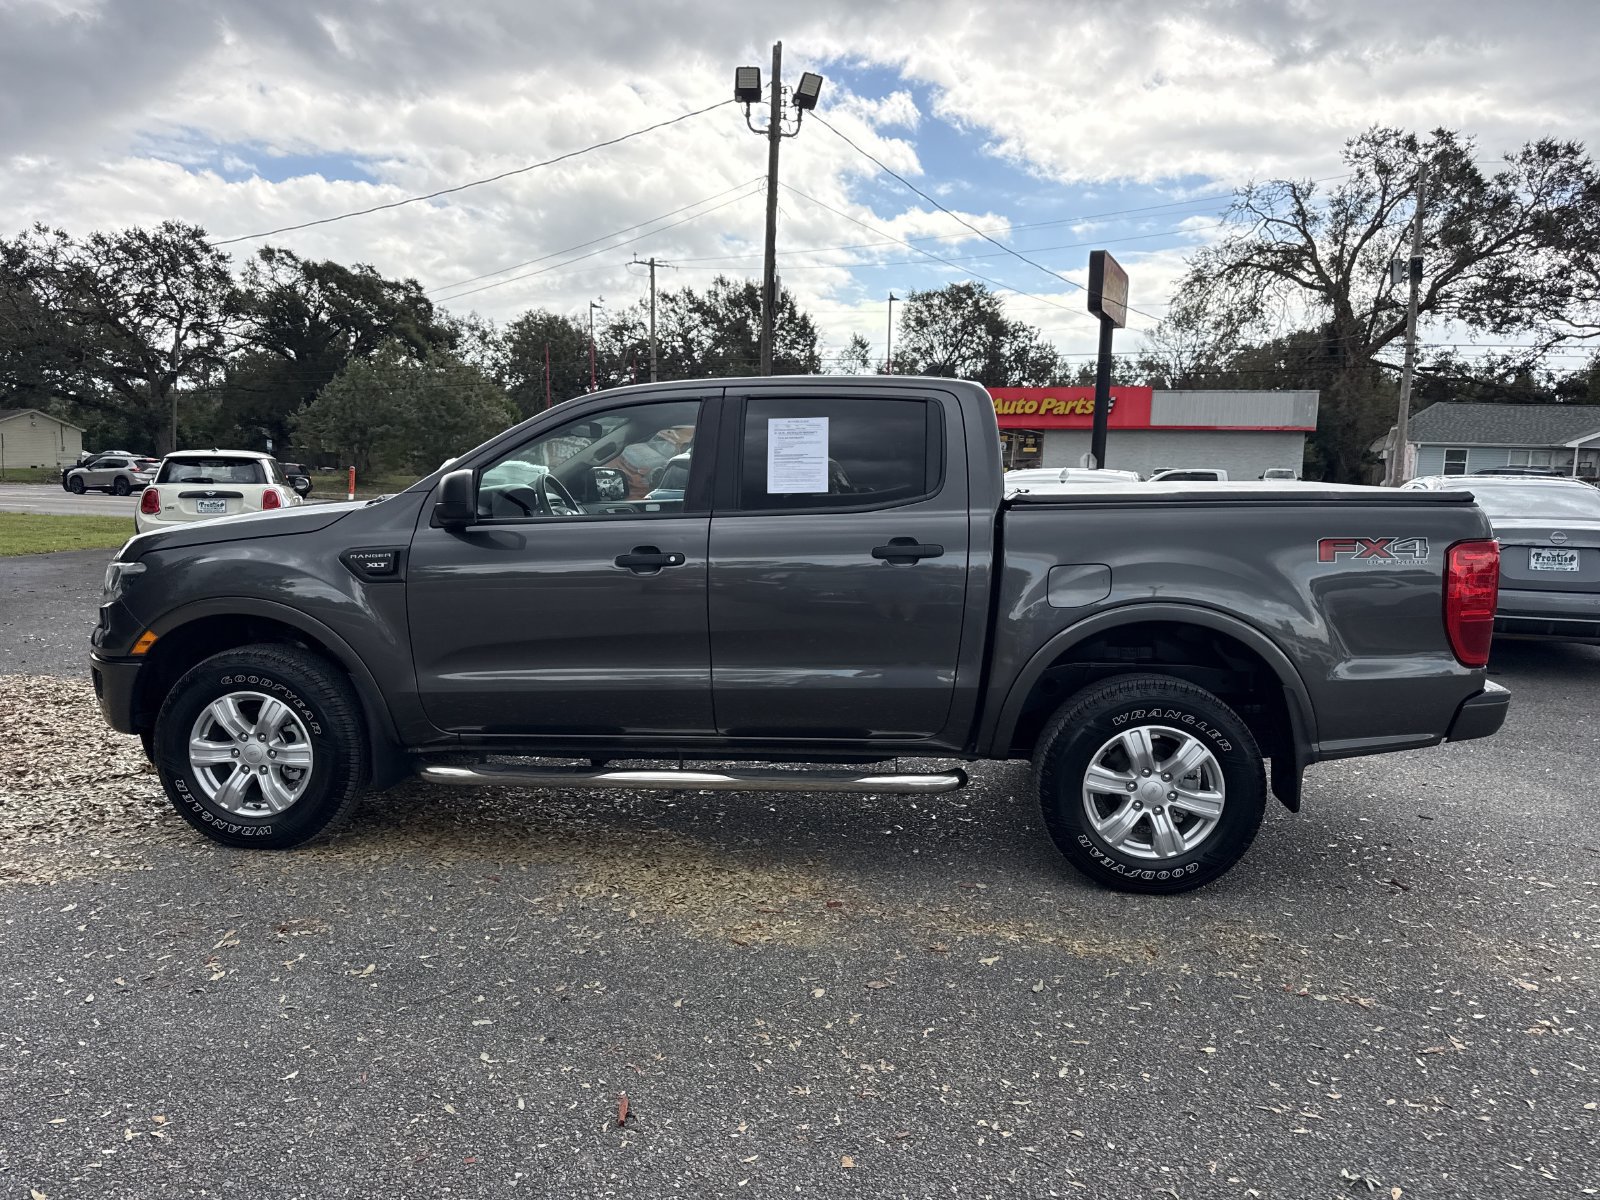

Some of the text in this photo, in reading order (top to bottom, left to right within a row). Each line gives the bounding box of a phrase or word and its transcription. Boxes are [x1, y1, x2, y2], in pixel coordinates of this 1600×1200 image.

[993, 397, 1095, 415] Auto Parts
[1316, 536, 1430, 564] FX4
[220, 674, 322, 735] GOODYEAR
[1112, 708, 1232, 752] WRANGLER
[175, 779, 272, 836] WRANGLER
[1077, 834, 1199, 880] GOODYEAR
